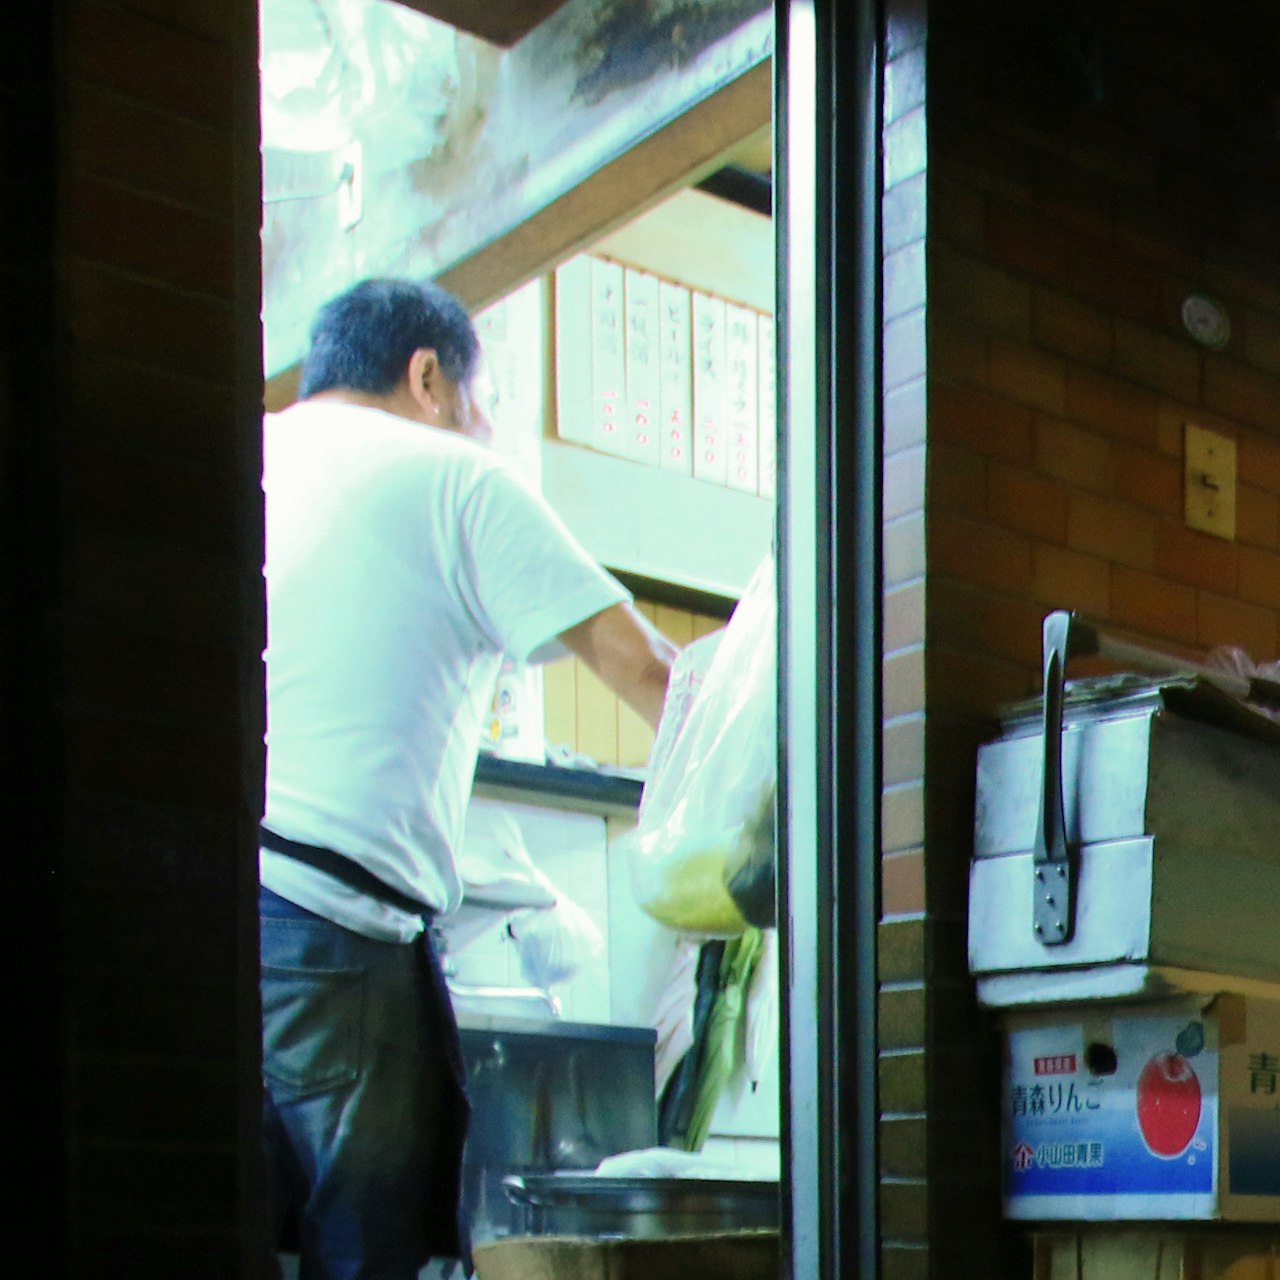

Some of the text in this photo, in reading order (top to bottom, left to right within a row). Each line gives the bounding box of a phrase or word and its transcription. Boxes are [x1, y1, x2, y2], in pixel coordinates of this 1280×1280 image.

[1012, 1078, 1104, 1116] 青森りんご
[1037, 1142, 1103, 1165] 小山田青果
